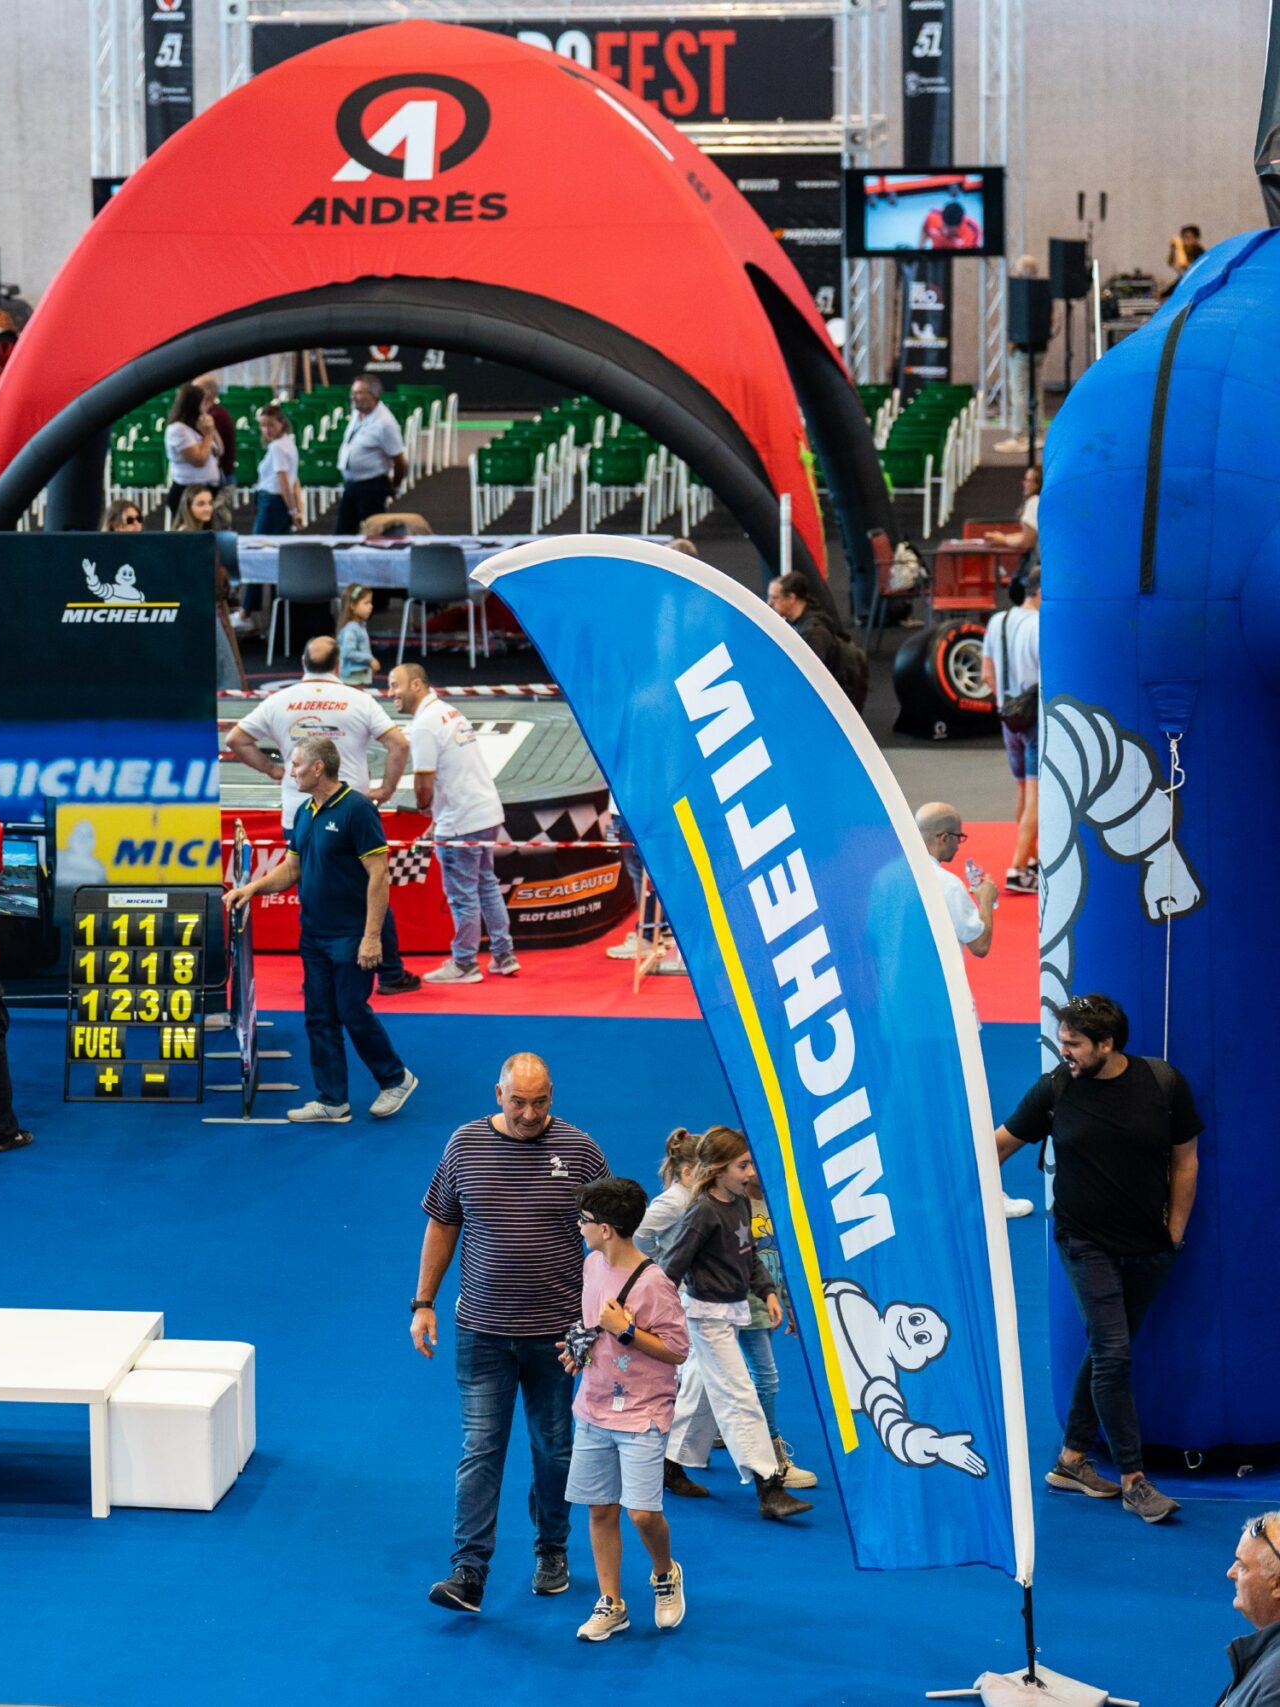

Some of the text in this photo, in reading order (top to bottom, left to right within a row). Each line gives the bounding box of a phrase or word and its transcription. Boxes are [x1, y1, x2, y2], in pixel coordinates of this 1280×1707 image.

[154, 33, 183, 67] 51
[912, 22, 943, 57] 51
[292, 191, 508, 225] ANDRÉS
[61, 609, 178, 623] MICHELIN
[516, 872, 614, 900] SCALEAUTO
[518, 912, 546, 922] SLOT
[674, 641, 896, 1262] MICHELIN
[74, 1027, 195, 1059] FUEL IN
